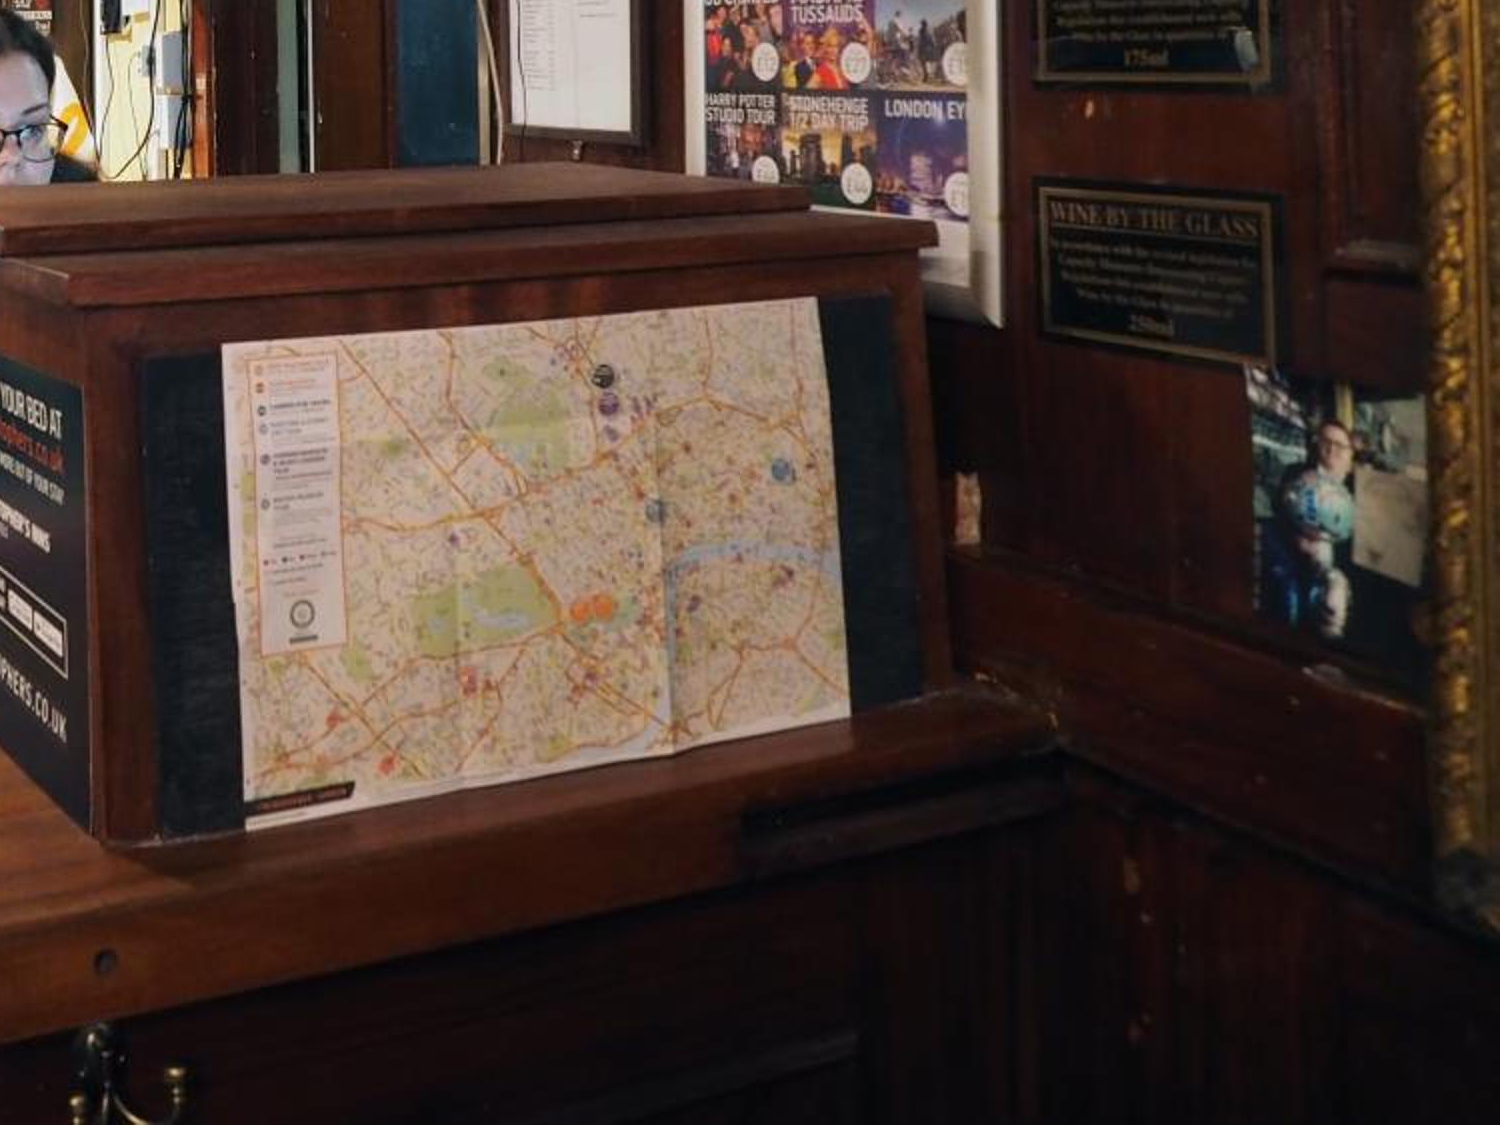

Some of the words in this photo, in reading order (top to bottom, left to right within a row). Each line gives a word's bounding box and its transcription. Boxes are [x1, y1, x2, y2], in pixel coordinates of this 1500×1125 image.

[789, 3, 865, 25] TUSSAUDS
[738, 93, 776, 108] POTTER
[788, 95, 869, 115] STONEHENGE
[885, 99, 943, 120] LONDON
[946, 100, 966, 120] EY
[746, 108, 776, 125] TOUR
[839, 112, 869, 132] TRIP
[1049, 201, 1102, 225] WINE
[1106, 205, 1130, 228] BY
[1137, 207, 1177, 232] THE
[1184, 212, 1259, 237] GLASS
[0, 380, 27, 421] YOUR
[27, 394, 50, 432] BED
[50, 407, 63, 440] AT
